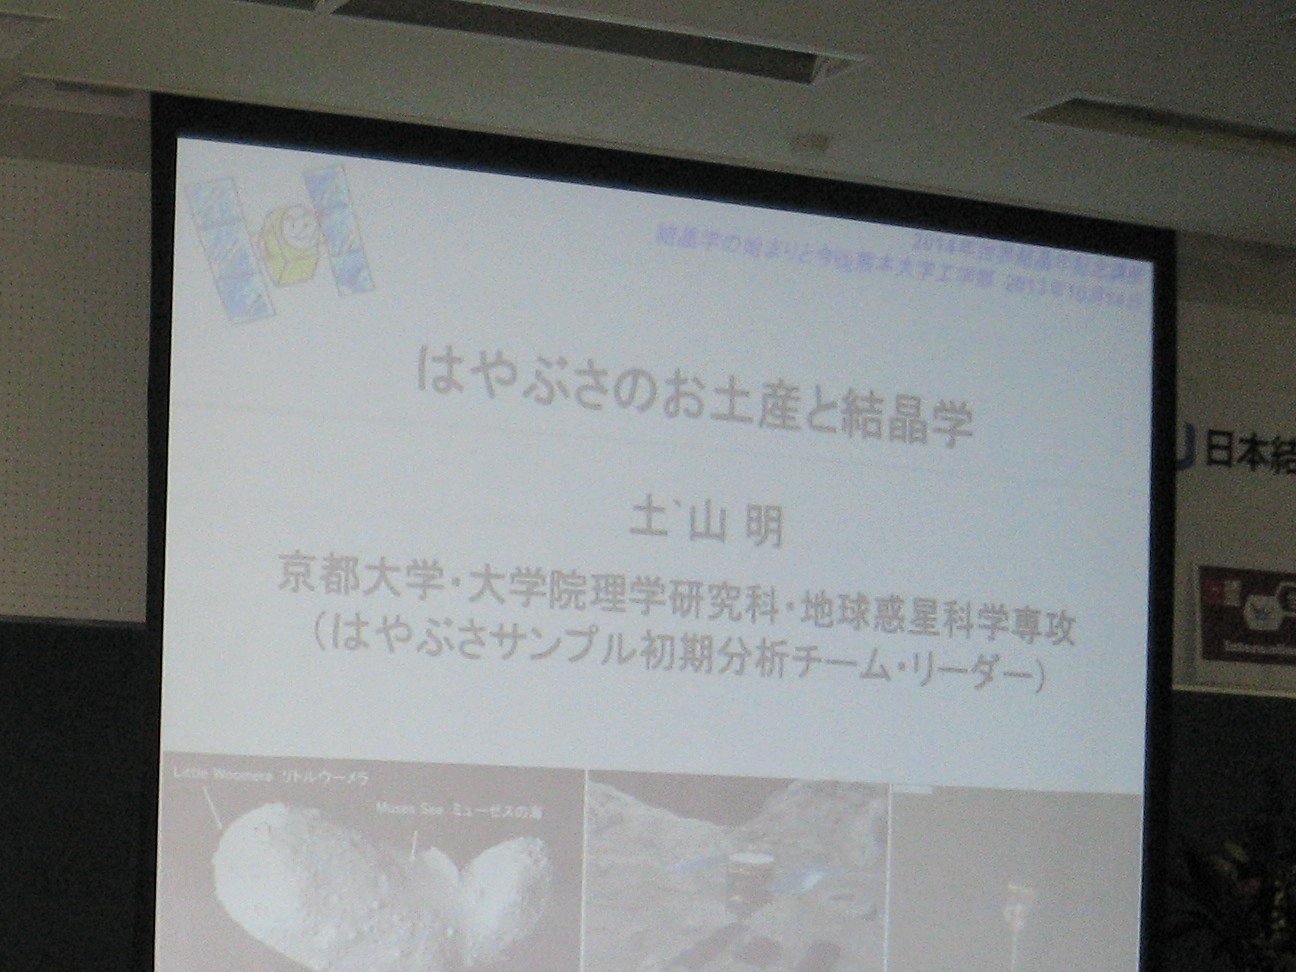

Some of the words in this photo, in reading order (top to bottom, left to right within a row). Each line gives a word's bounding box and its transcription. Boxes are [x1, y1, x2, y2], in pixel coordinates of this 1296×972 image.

[417, 345, 974, 449] はやぶさのお土産と結晶学
